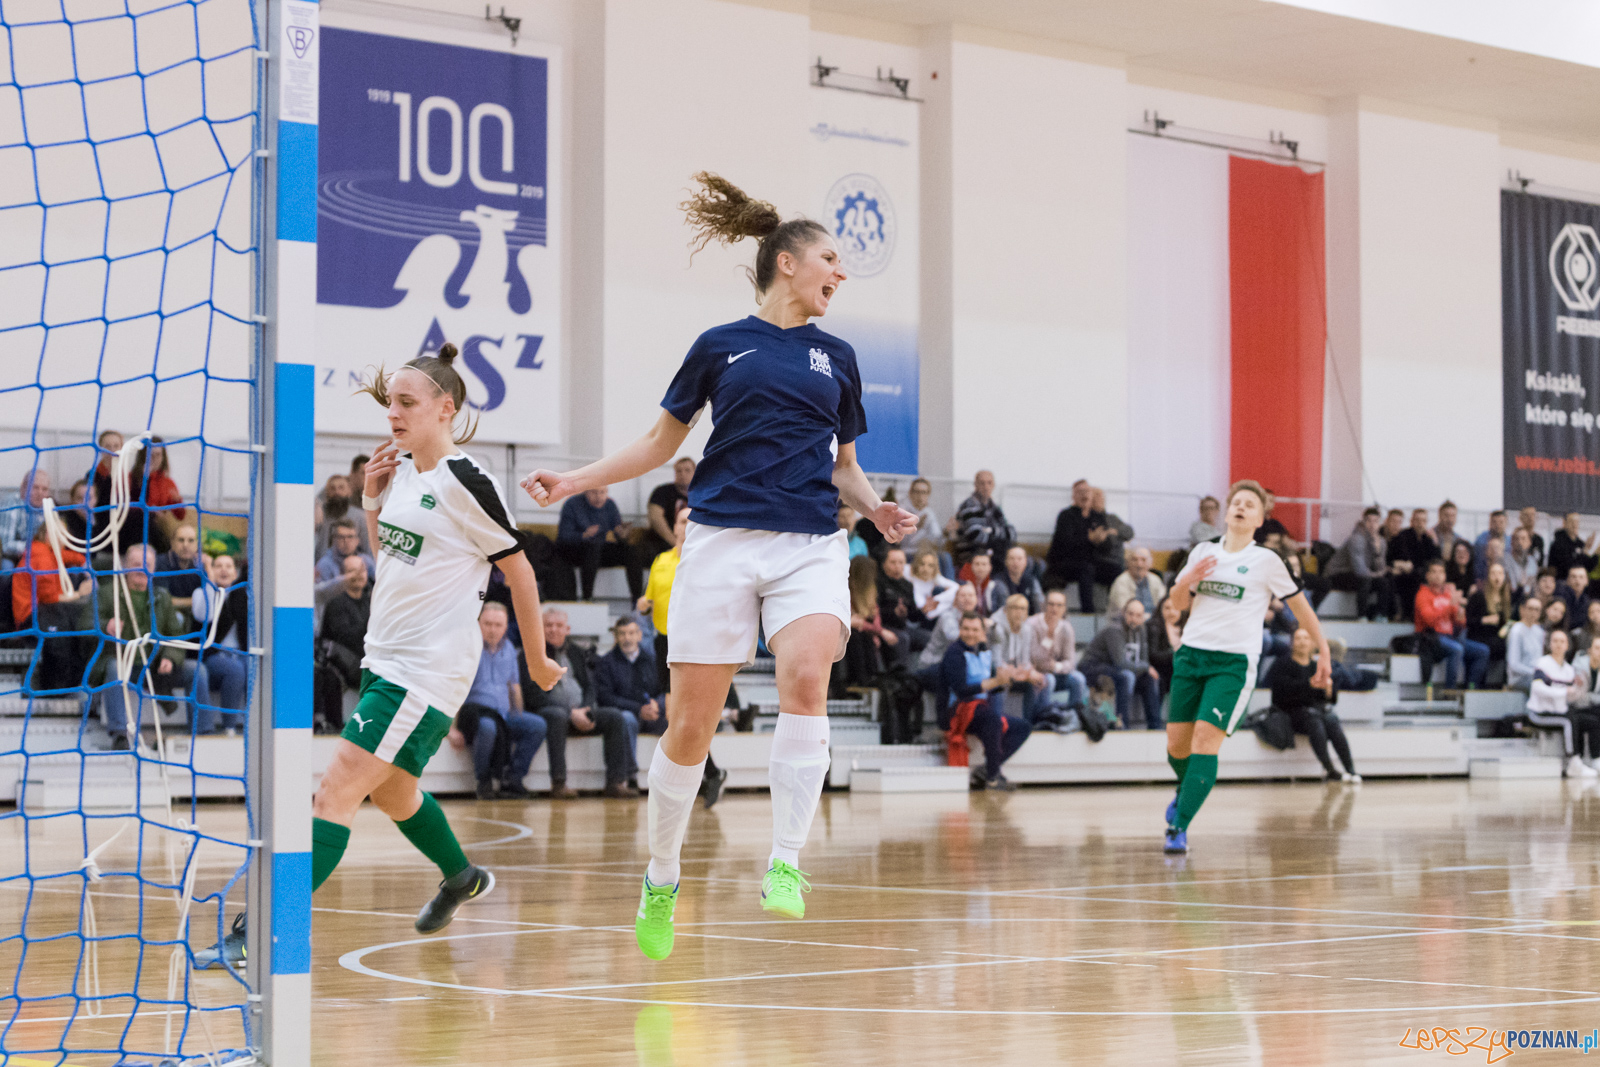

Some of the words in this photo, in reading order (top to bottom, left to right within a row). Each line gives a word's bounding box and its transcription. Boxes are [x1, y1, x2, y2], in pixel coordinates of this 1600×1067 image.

[368, 89, 390, 103] 1919
[520, 184, 544, 199] 2019
[1525, 402, 1568, 427] które
[1570, 407, 1595, 434] się
[1514, 454, 1600, 477] www.rebis.
